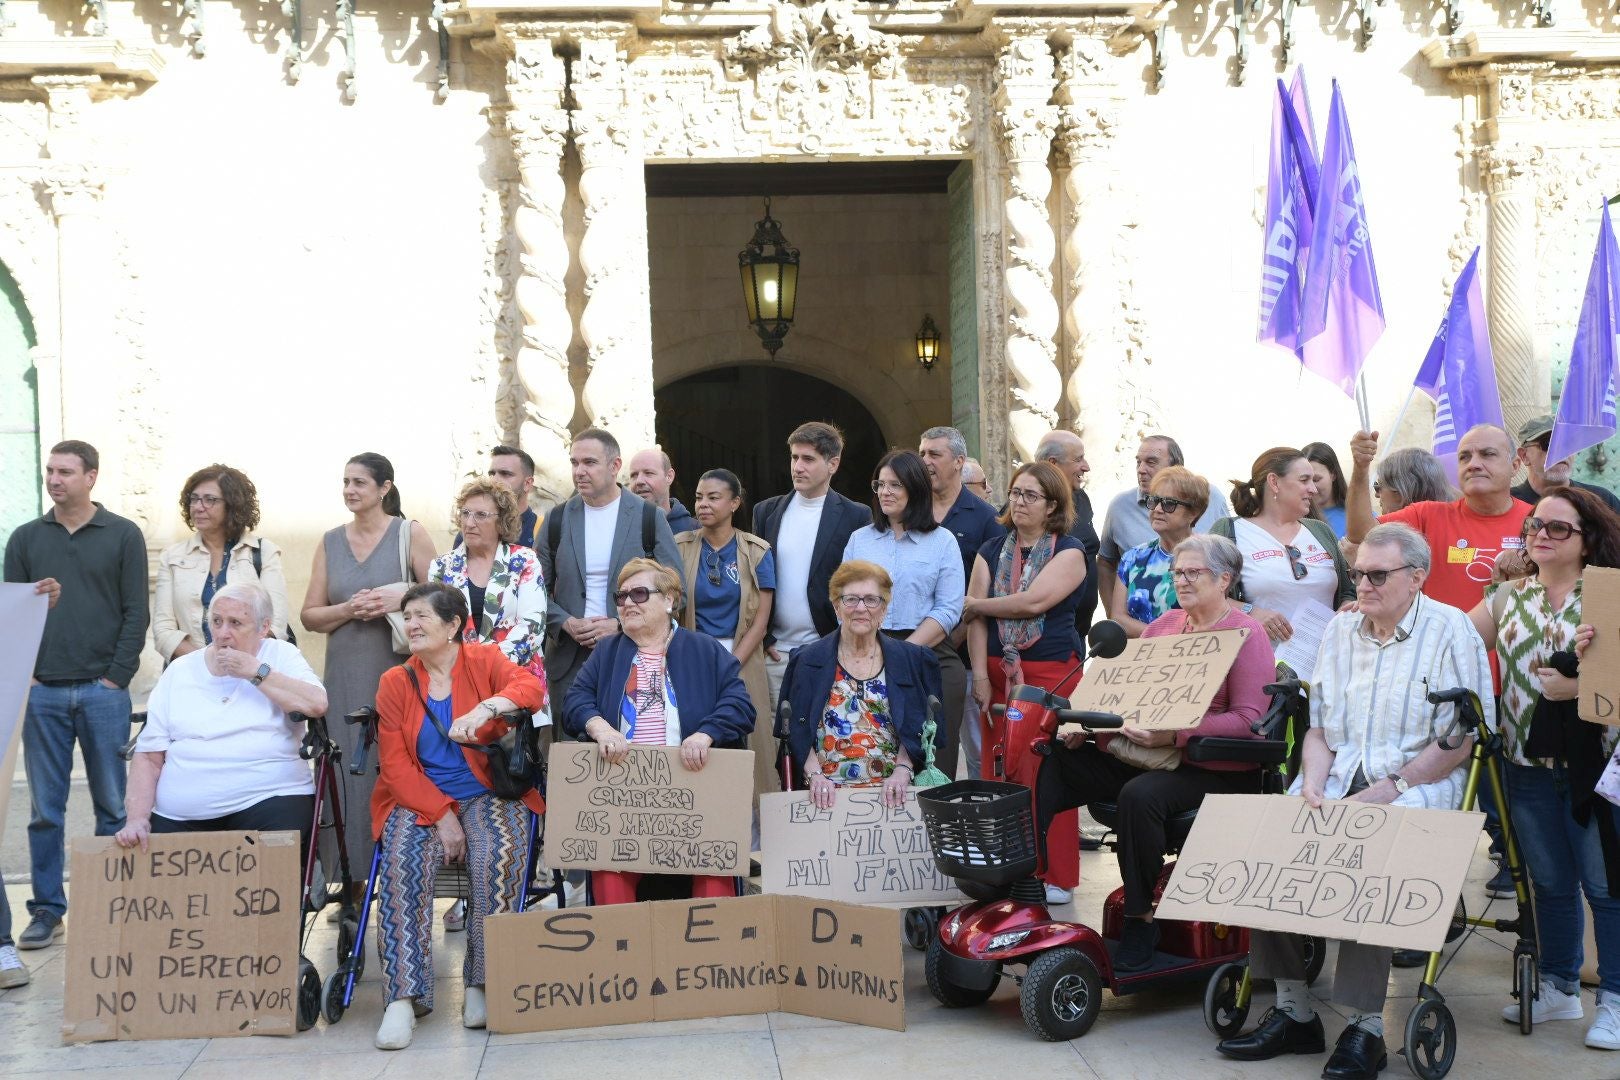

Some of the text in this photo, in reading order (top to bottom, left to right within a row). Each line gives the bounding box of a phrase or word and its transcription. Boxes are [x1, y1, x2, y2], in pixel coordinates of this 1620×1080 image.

[1133, 643, 1157, 662] EL
[1094, 662, 1209, 687] NECESITA
[1100, 682, 1206, 707] UN LOCAL
[565, 750, 672, 787] SUSANA
[588, 786, 694, 810] CAMARERO
[844, 790, 926, 827] SE
[576, 811, 703, 840] LOS MAYORES
[1292, 801, 1387, 839] NO
[105, 853, 135, 882] UN
[560, 838, 738, 871] SON LO PRIMERO
[1291, 841, 1363, 869] A LA
[109, 887, 281, 924] PARA EL SED
[1167, 860, 1443, 926] SOLEDAD
[168, 928, 205, 950] ES
[90, 952, 282, 980] UN DERECHO
[96, 987, 293, 1017] NO UN FAVOR
